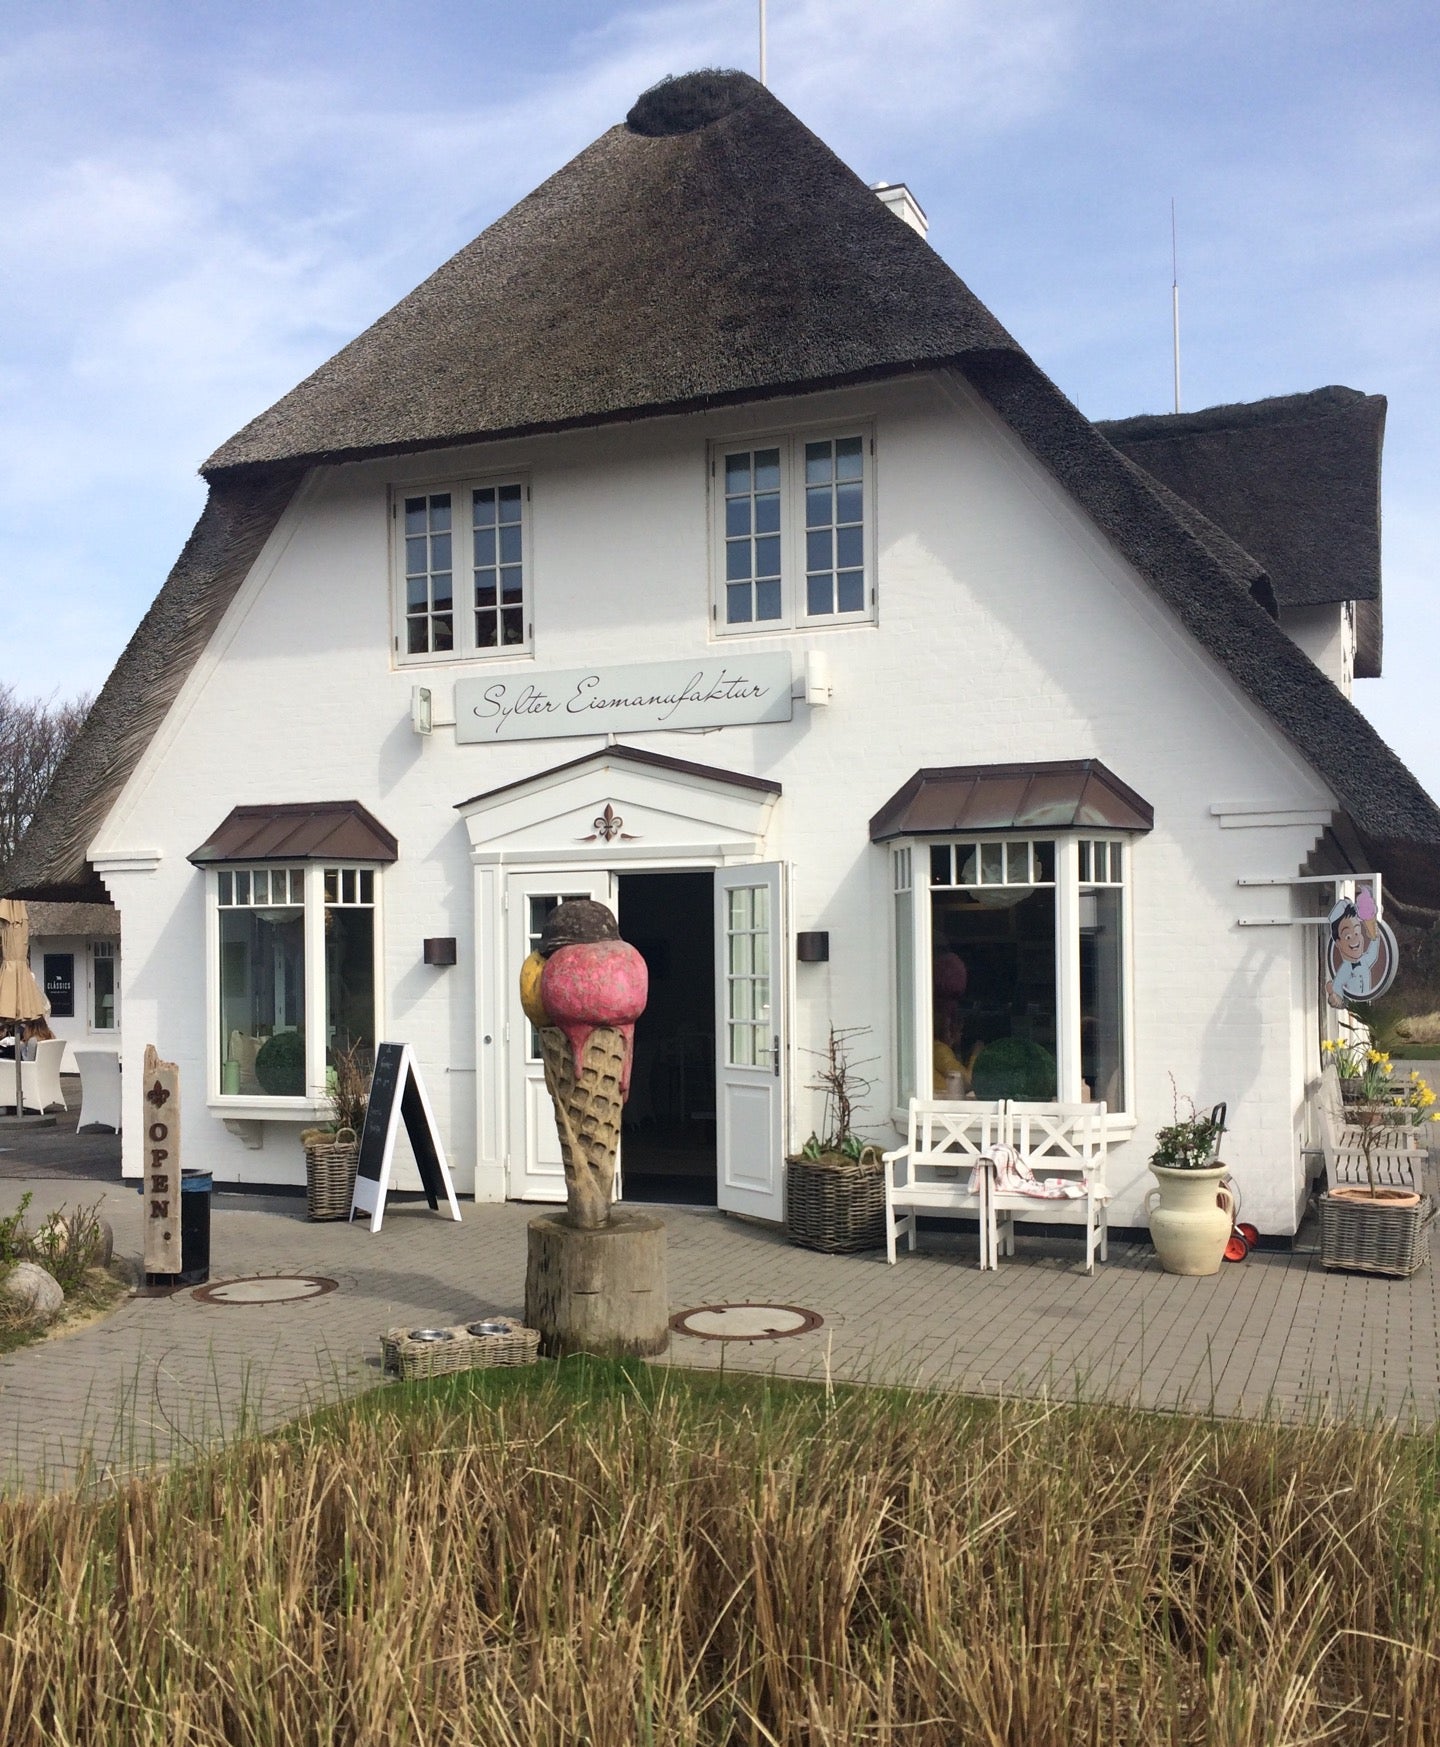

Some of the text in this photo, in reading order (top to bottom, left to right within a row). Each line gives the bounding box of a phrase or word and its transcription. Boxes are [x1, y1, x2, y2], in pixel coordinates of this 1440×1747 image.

[474, 669, 770, 733] Sylter Eismanufaktur
[148, 1122, 170, 1219] OPEN
